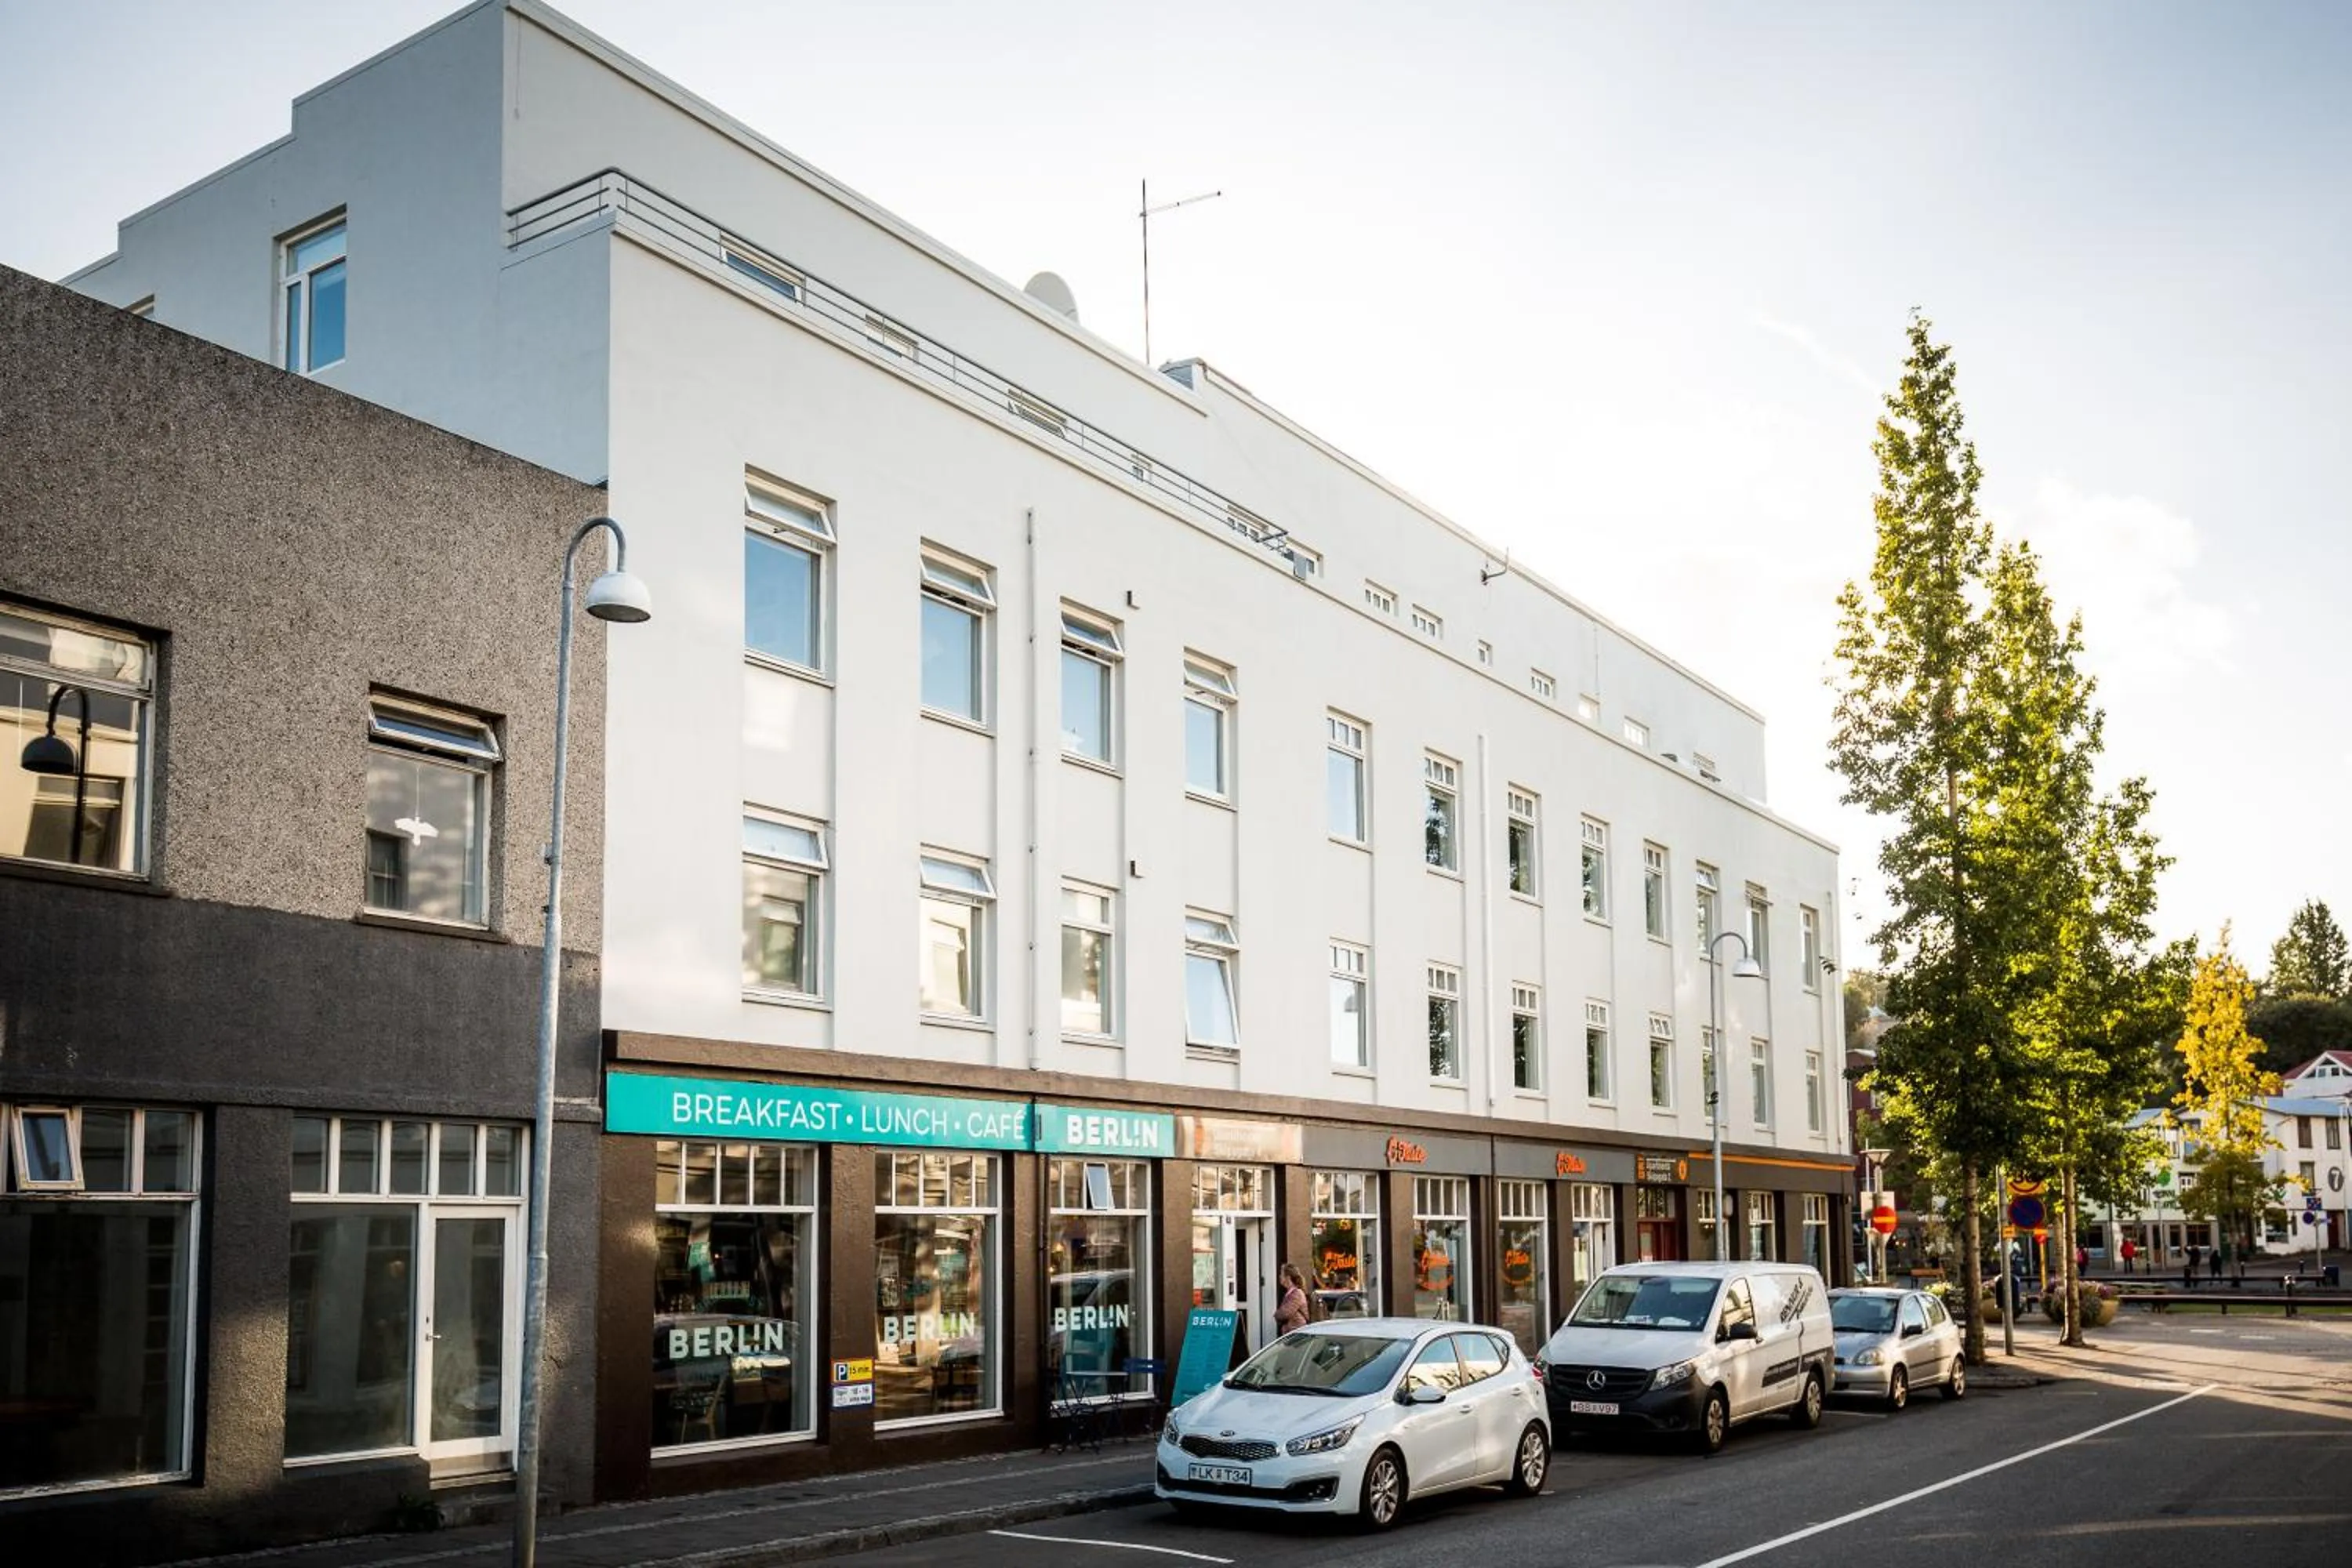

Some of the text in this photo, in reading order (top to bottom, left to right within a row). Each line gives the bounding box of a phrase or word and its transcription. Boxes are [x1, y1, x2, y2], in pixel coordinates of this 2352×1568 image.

[672, 1091, 1026, 1141] BREAKFAST LUNCH CAFÉ
[2331, 1168, 2340, 1189] 7
[1225, 1468, 1248, 1482] T34
